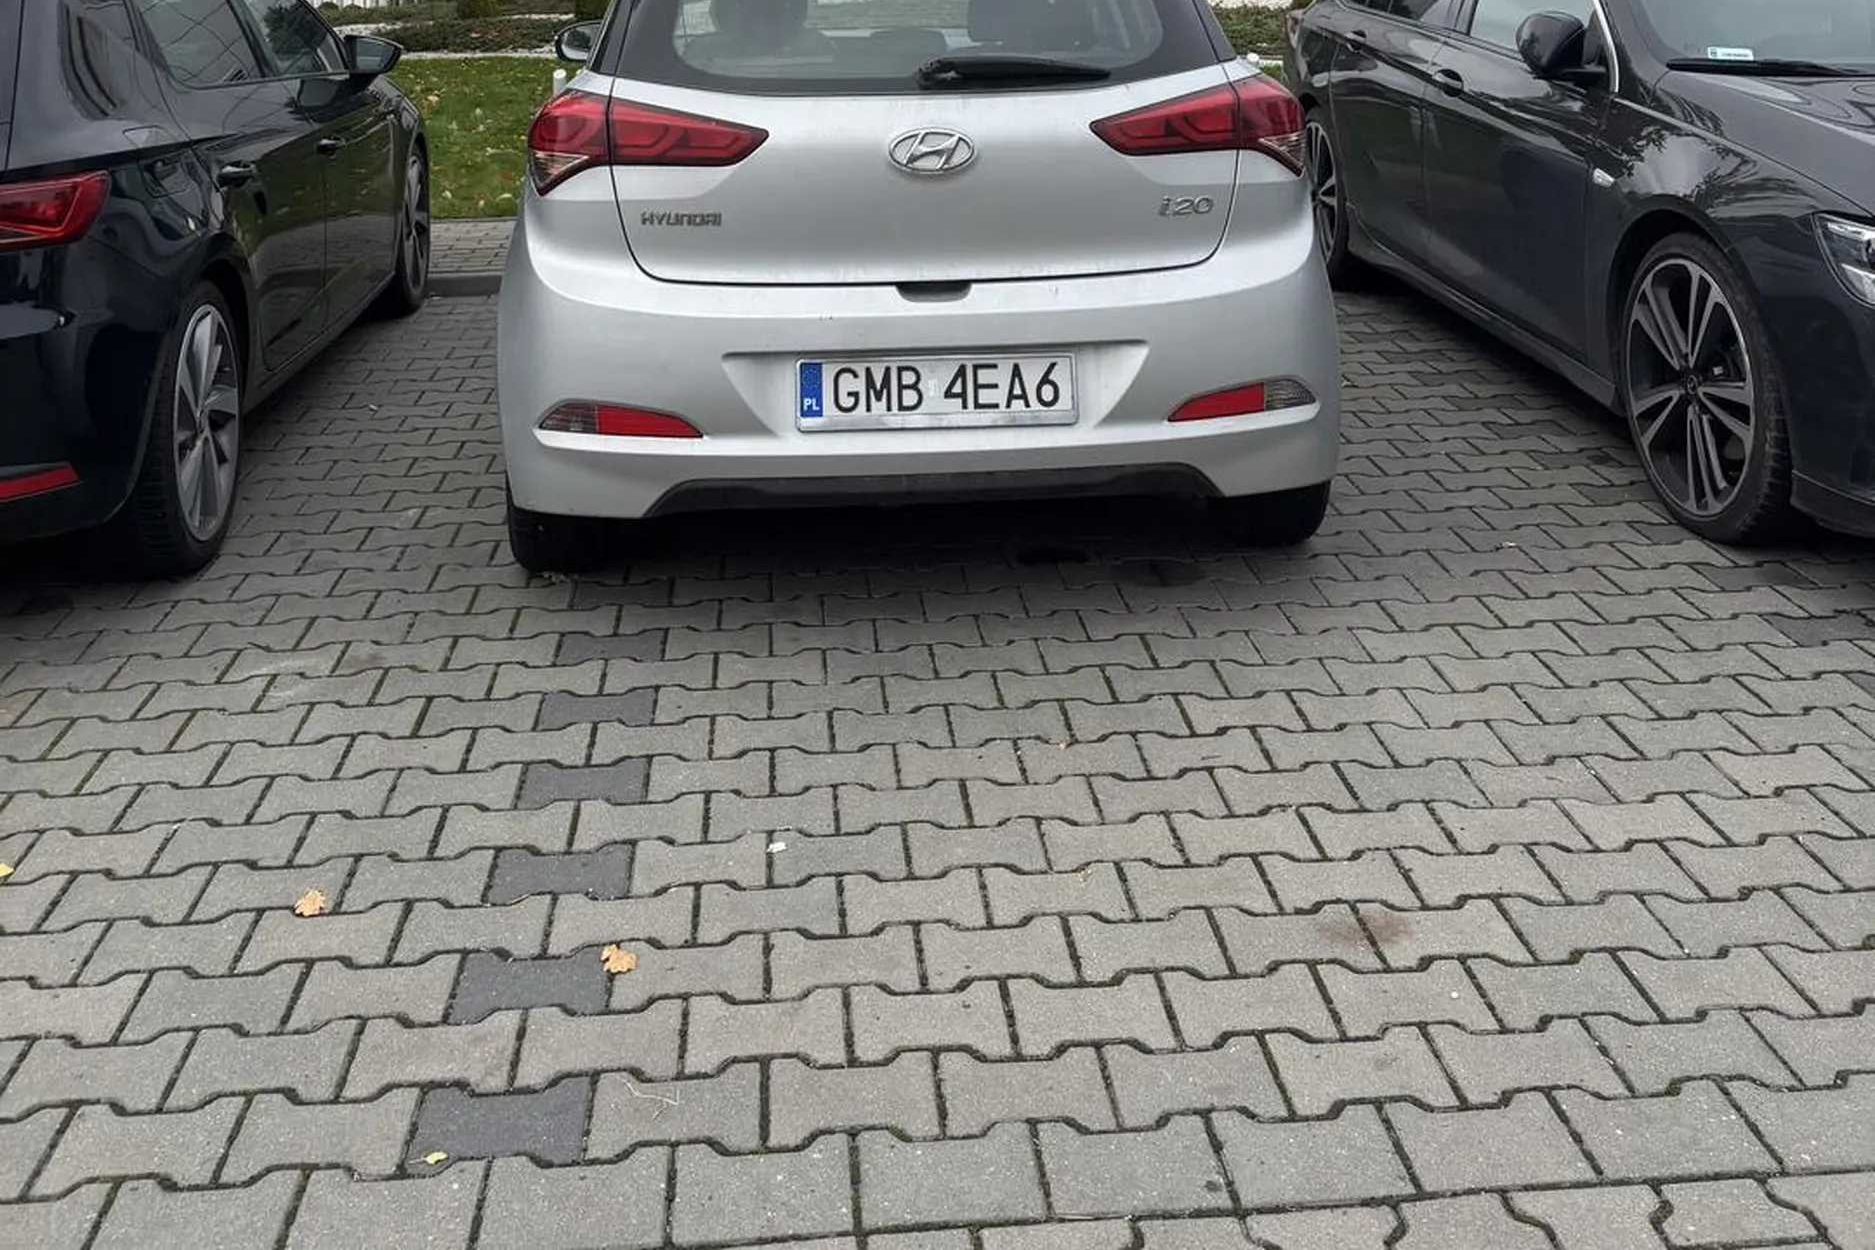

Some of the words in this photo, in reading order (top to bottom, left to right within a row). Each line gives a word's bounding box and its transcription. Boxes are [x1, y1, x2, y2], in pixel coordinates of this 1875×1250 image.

[1159, 196, 1213, 217] i20
[641, 211, 722, 227] HYUNDAI
[833, 365, 923, 413] GMB
[944, 361, 1060, 411] 4EA6
[803, 398, 820, 411] PL
